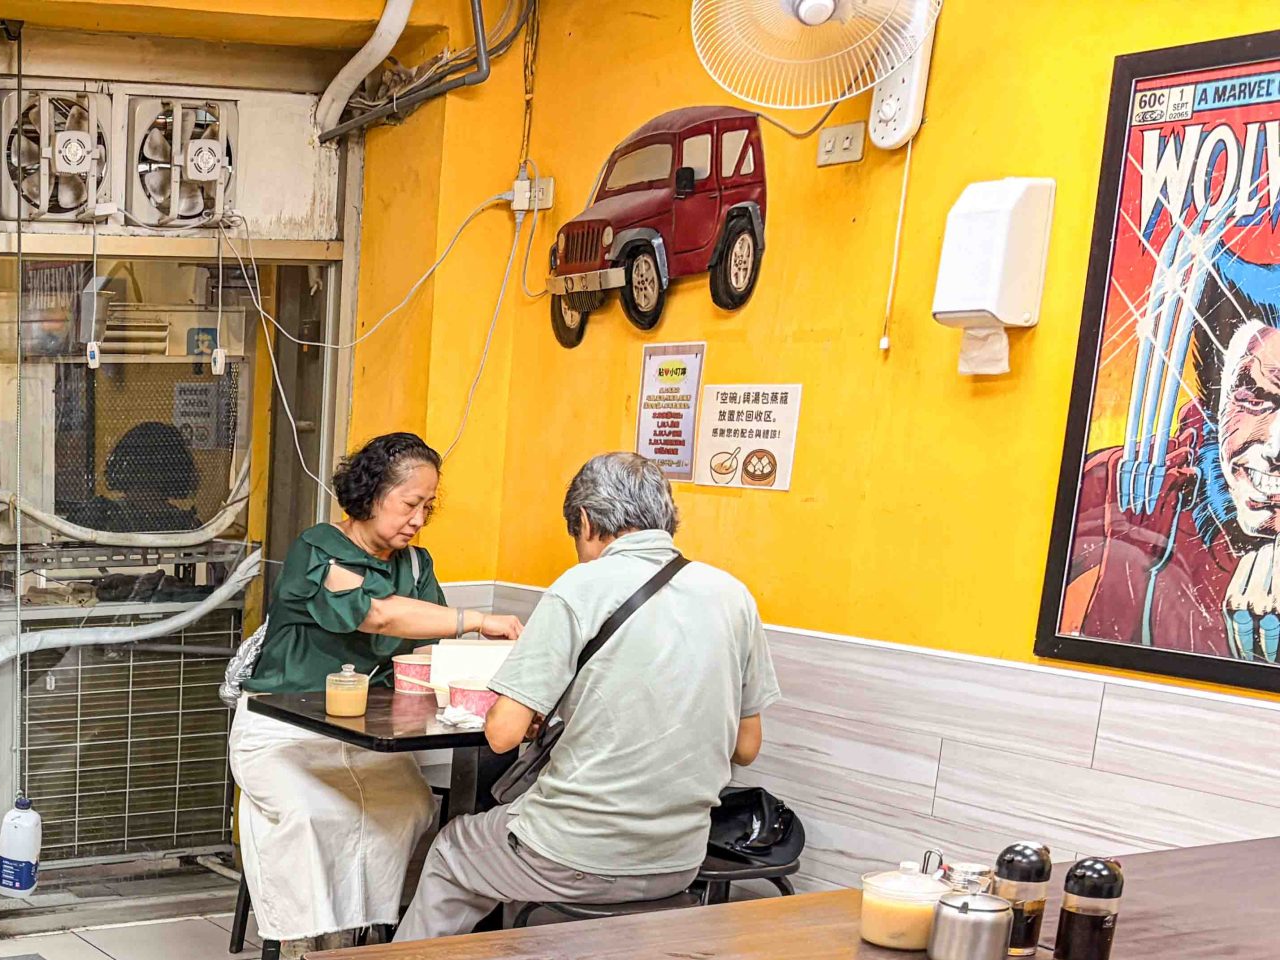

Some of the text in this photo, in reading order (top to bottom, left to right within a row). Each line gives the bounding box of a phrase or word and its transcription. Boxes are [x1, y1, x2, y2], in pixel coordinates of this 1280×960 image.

[1179, 88, 1184, 102] 1
[1197, 87, 1208, 106] A
[1212, 78, 1272, 104] MARVEL
[1172, 102, 1189, 112] SEPT
[1168, 111, 1189, 120] 02065
